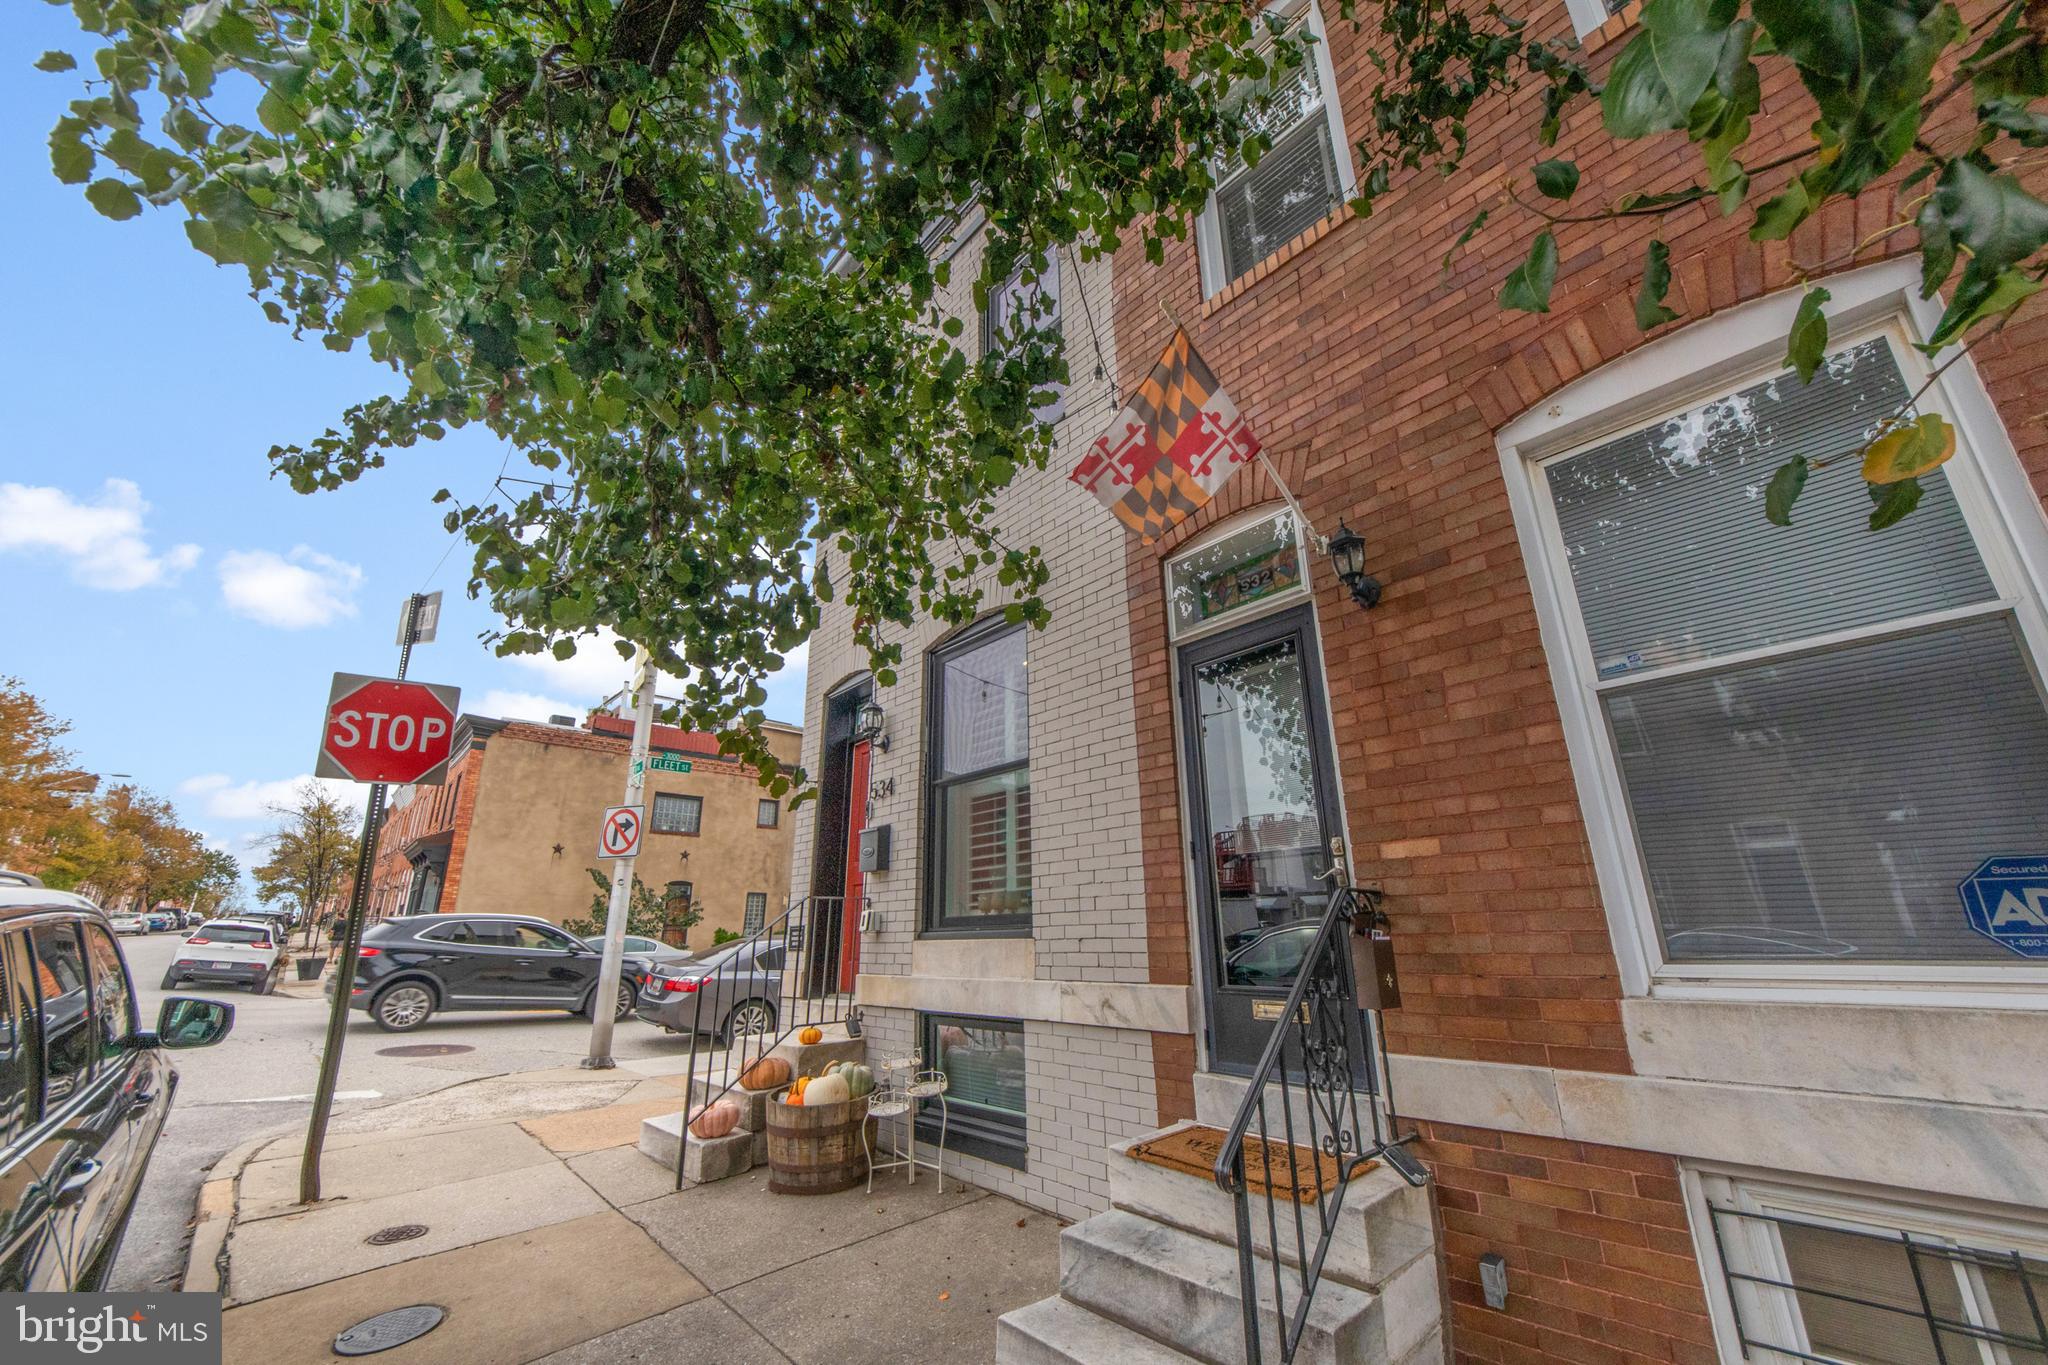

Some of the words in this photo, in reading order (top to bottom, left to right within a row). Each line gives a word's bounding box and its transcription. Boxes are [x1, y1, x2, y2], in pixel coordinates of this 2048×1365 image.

[1240, 570, 1272, 592] 532
[334, 710, 446, 752] STOP
[653, 759, 680, 772] FLEET
[871, 777, 894, 800] 534
[1991, 865, 2048, 874] Secured
